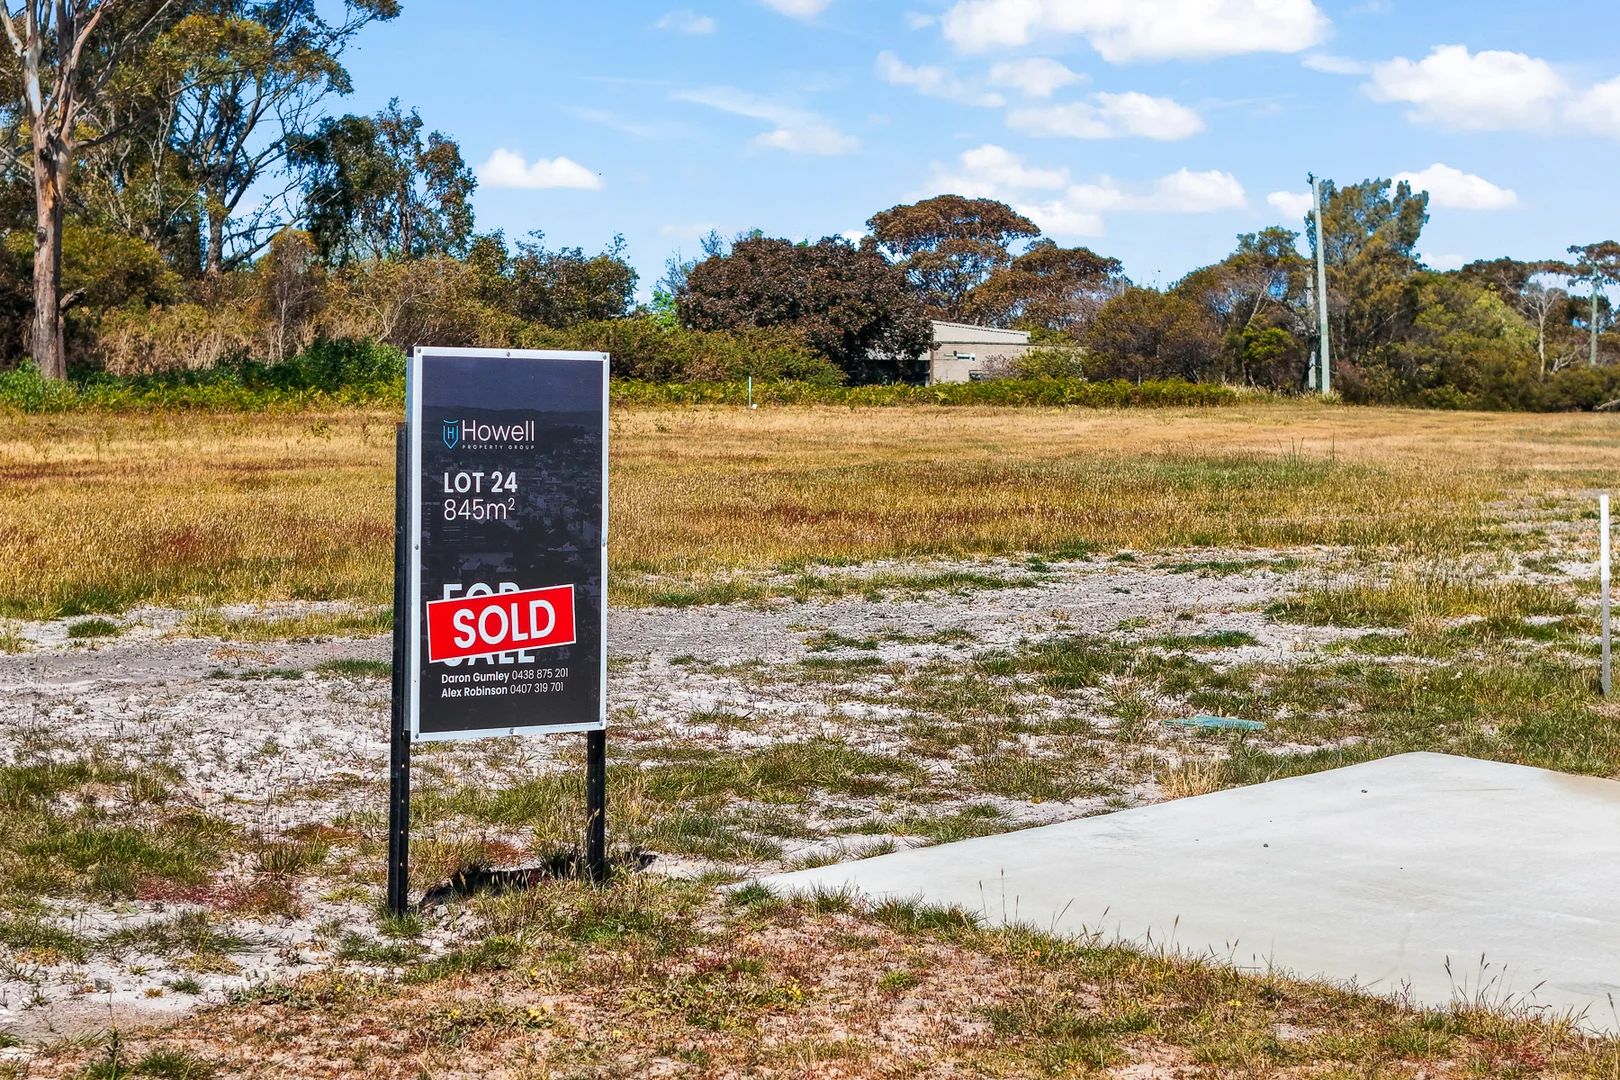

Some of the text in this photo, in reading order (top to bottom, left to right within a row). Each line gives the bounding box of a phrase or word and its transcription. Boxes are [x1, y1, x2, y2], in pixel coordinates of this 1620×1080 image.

[462, 419, 535, 441] Howell
[444, 471, 518, 493] LOT 24
[453, 599, 556, 649] SOLD
[441, 667, 569, 684] Daron Gumley 0438 875 201
[441, 681, 564, 698] Alex Robinson 0407 319 701
